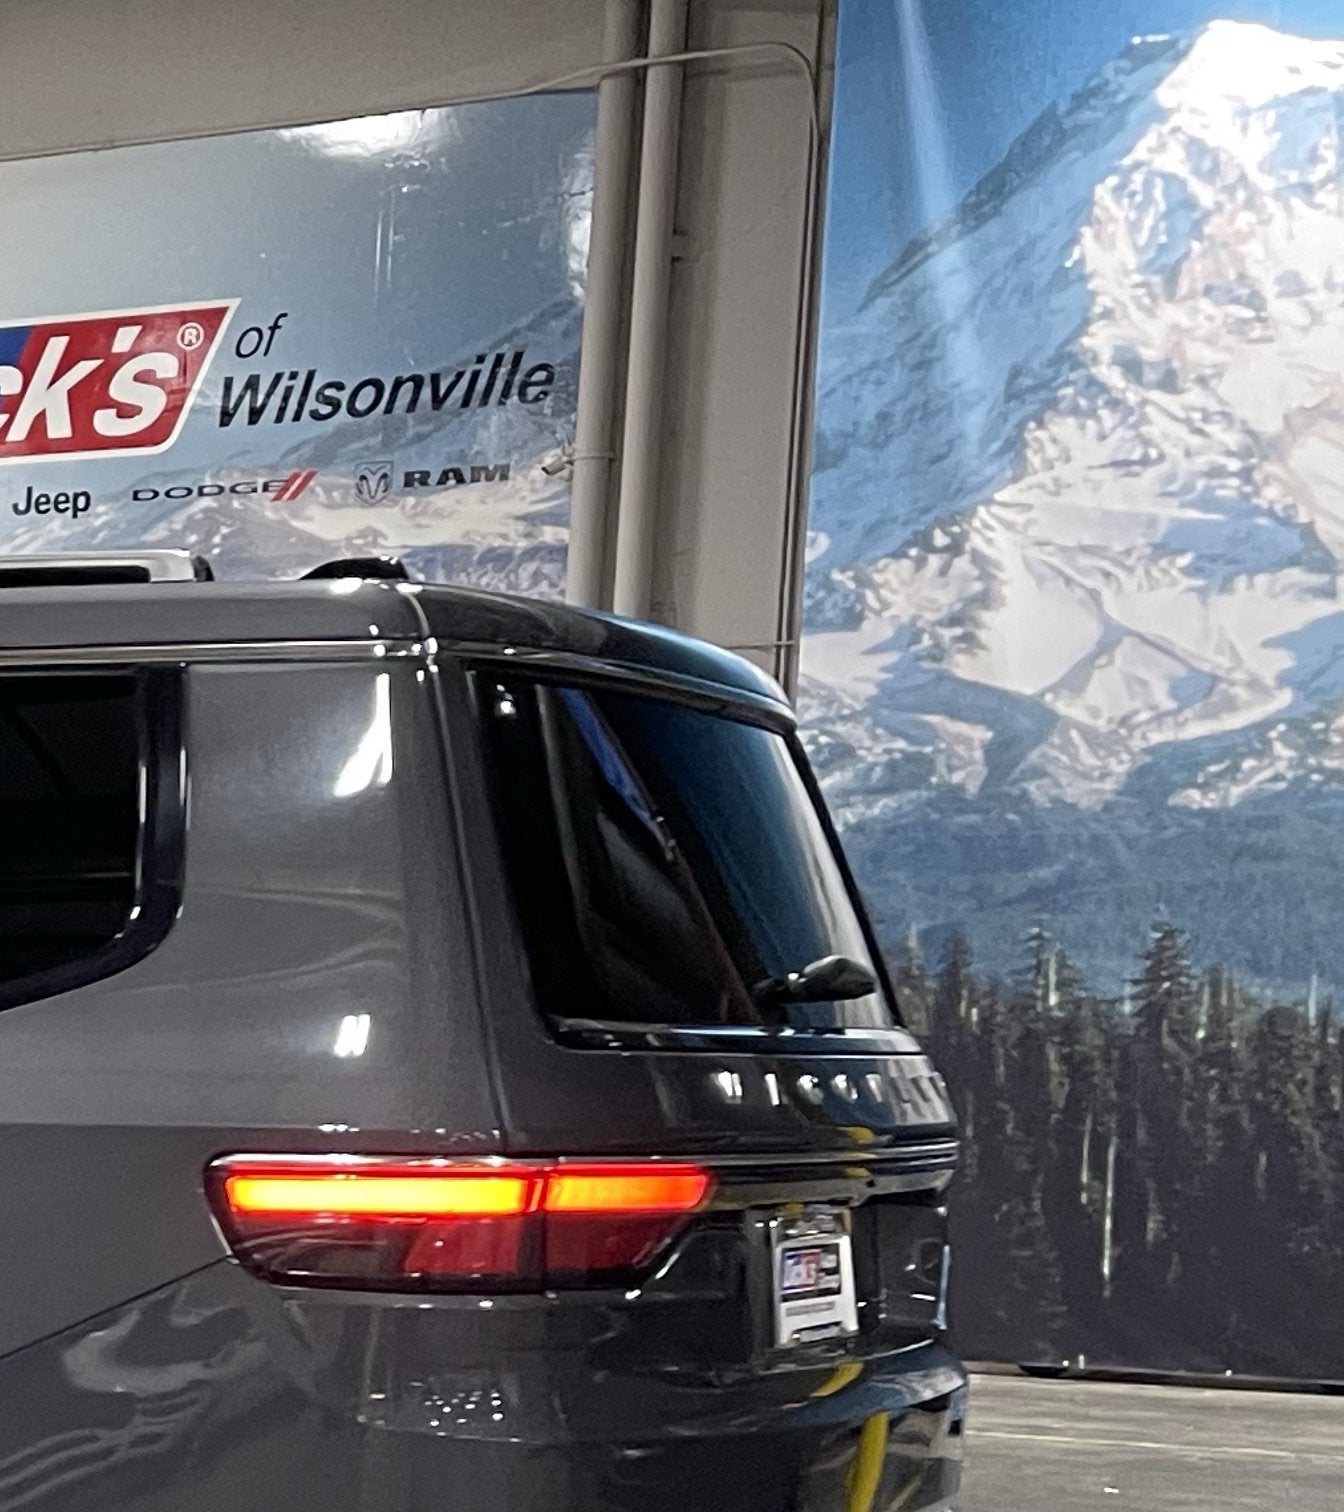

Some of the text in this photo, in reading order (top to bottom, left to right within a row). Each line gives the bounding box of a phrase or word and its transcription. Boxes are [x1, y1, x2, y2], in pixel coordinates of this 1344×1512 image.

[234, 312, 288, 359] of
[218, 351, 555, 427] Wilsonville
[132, 479, 286, 502] DODGE
[402, 463, 511, 488] RAM
[12, 485, 92, 519] Jeep
